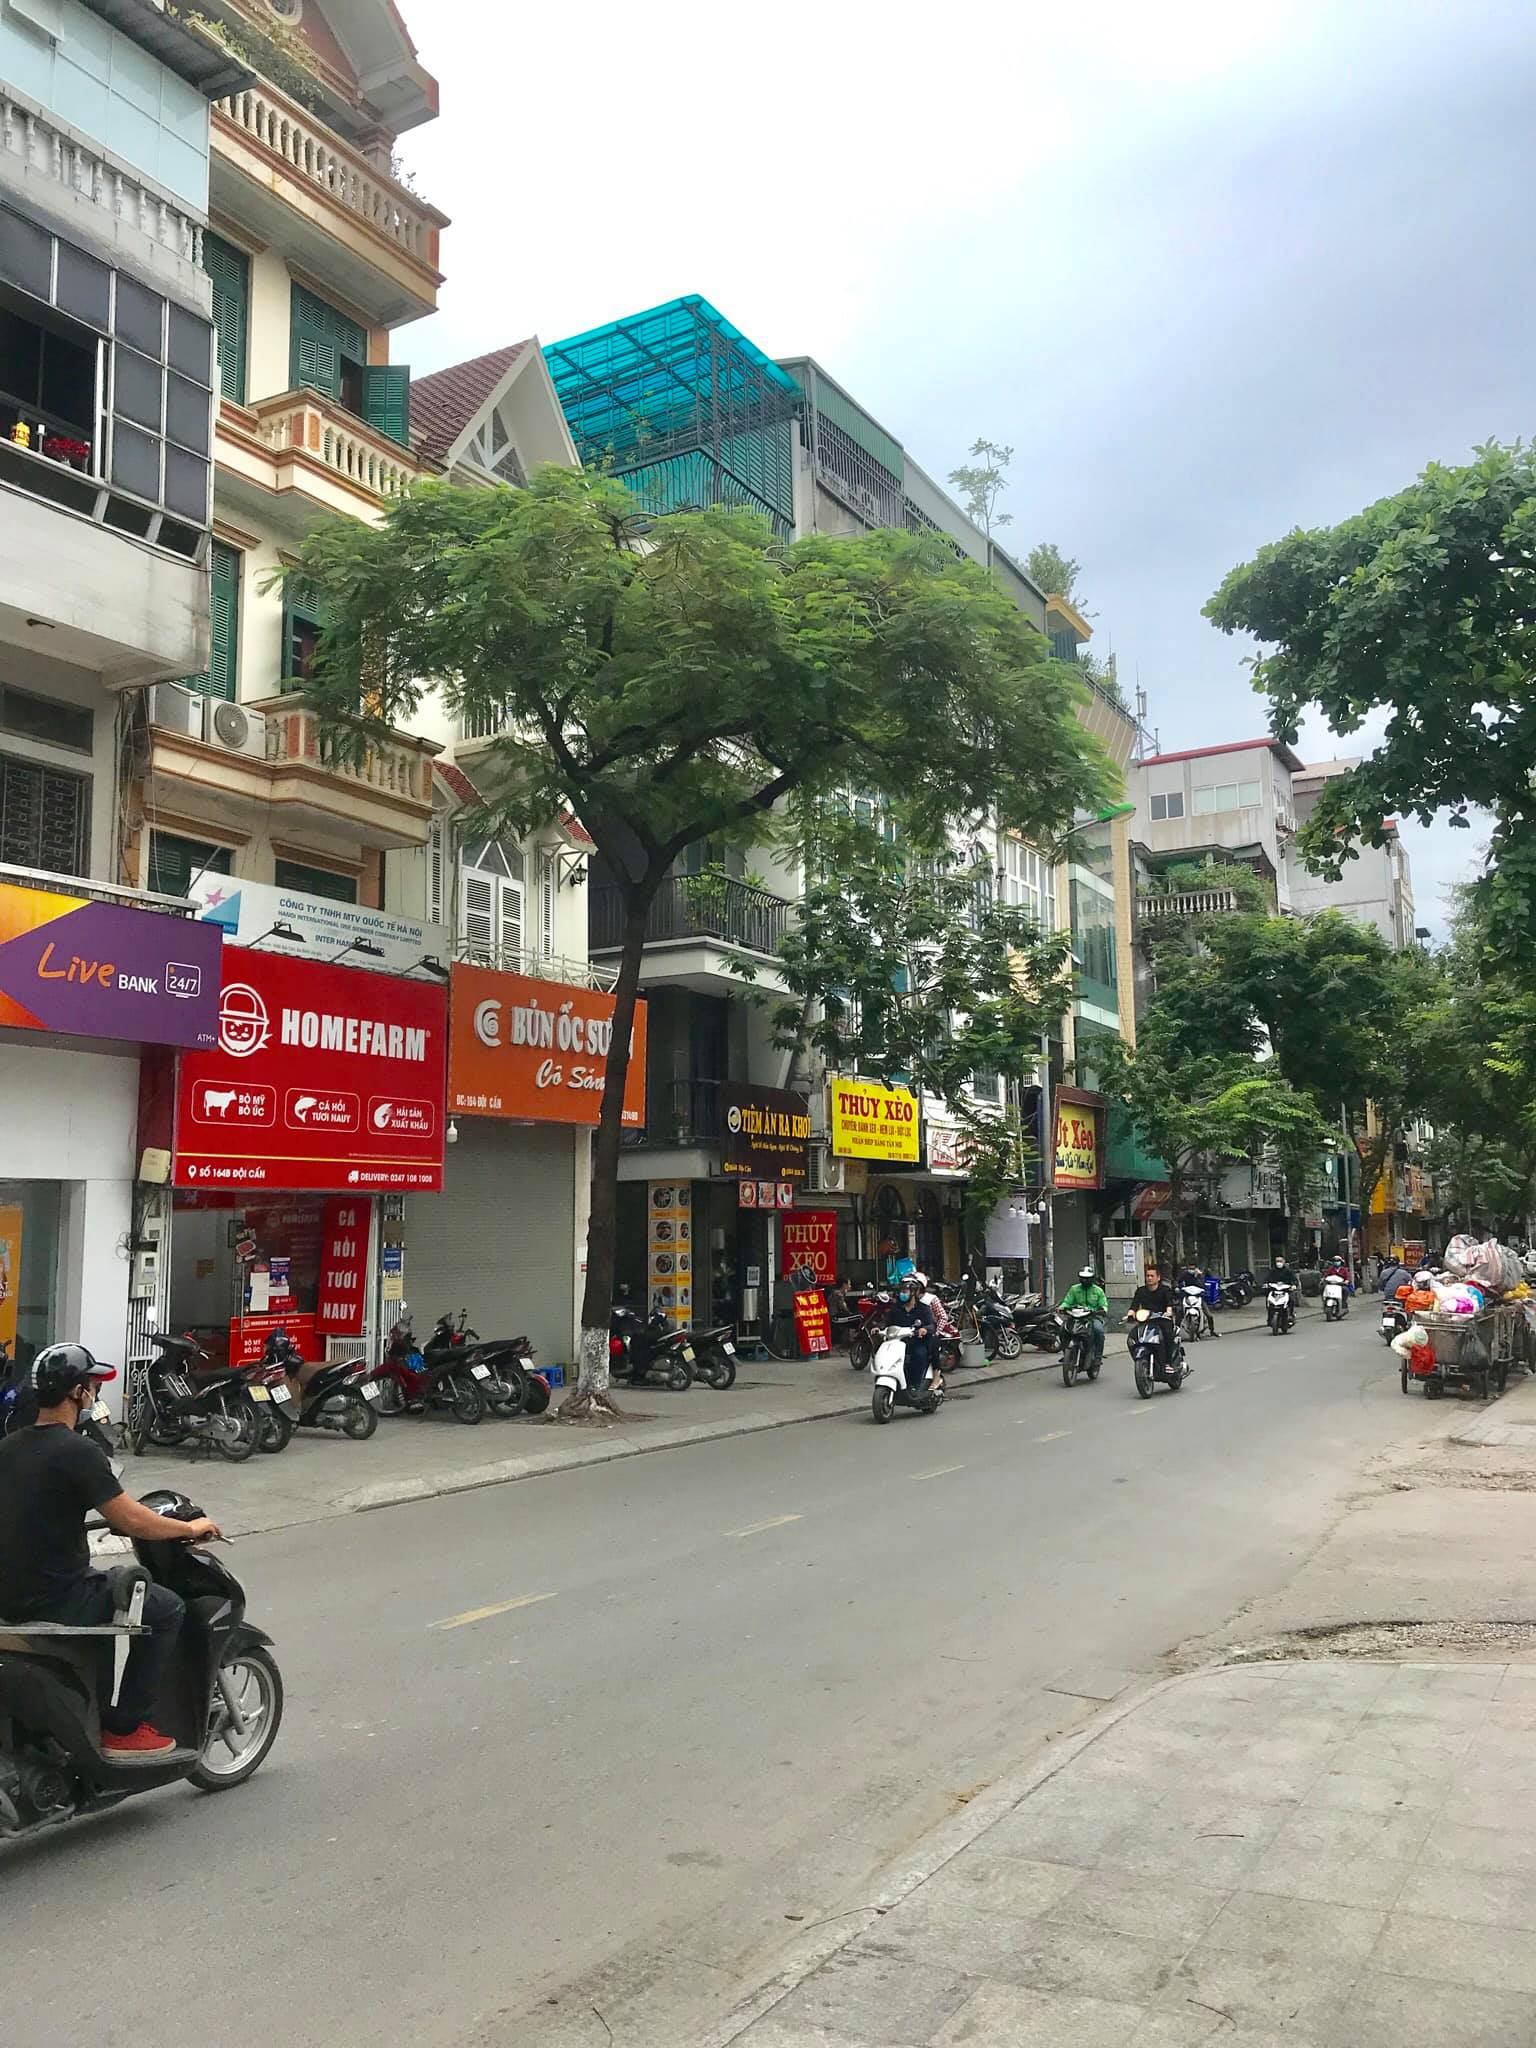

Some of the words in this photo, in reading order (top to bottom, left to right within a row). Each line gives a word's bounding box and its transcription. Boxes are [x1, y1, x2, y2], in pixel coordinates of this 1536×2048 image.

[280, 898, 304, 911] CÔNG
[306, 904, 317, 913] TY
[320, 907, 341, 919] TNHH
[343, 912, 361, 923] MTV
[362, 916, 385, 929] QUỐC
[387, 921, 396, 931] TẾ
[38, 942, 115, 987] Live
[118, 974, 158, 994] BANK
[169, 975, 197, 992] 24/7
[281, 1008, 425, 1062] HOMEFARM
[535, 1058, 563, 1089] Cô
[238, 1092, 250, 1104] BÒ
[252, 1094, 265, 1105] MỸ
[318, 1100, 330, 1111] CÁ
[332, 1099, 345, 1112] HỒI
[838, 1089, 880, 1119] THỦY
[884, 1095, 912, 1122] XÈO
[238, 1105, 250, 1115] BÒ
[252, 1105, 265, 1116] ÚC
[331, 1113, 351, 1123] NAUY
[764, 1104, 777, 1136] ĂN
[779, 1113, 790, 1137] RA
[391, 1117, 408, 1129] XUẤT
[1071, 1119, 1093, 1151] Xèo
[199, 1165, 211, 1177] SỐ
[232, 1166, 247, 1180] ĐỘI
[338, 1209, 355, 1226] CÁ
[784, 1215, 832, 1243] THỦY
[790, 1246, 827, 1271] XÈO
[327, 1270, 357, 1289] TƯƠI
[322, 1303, 356, 1320] NAUY
